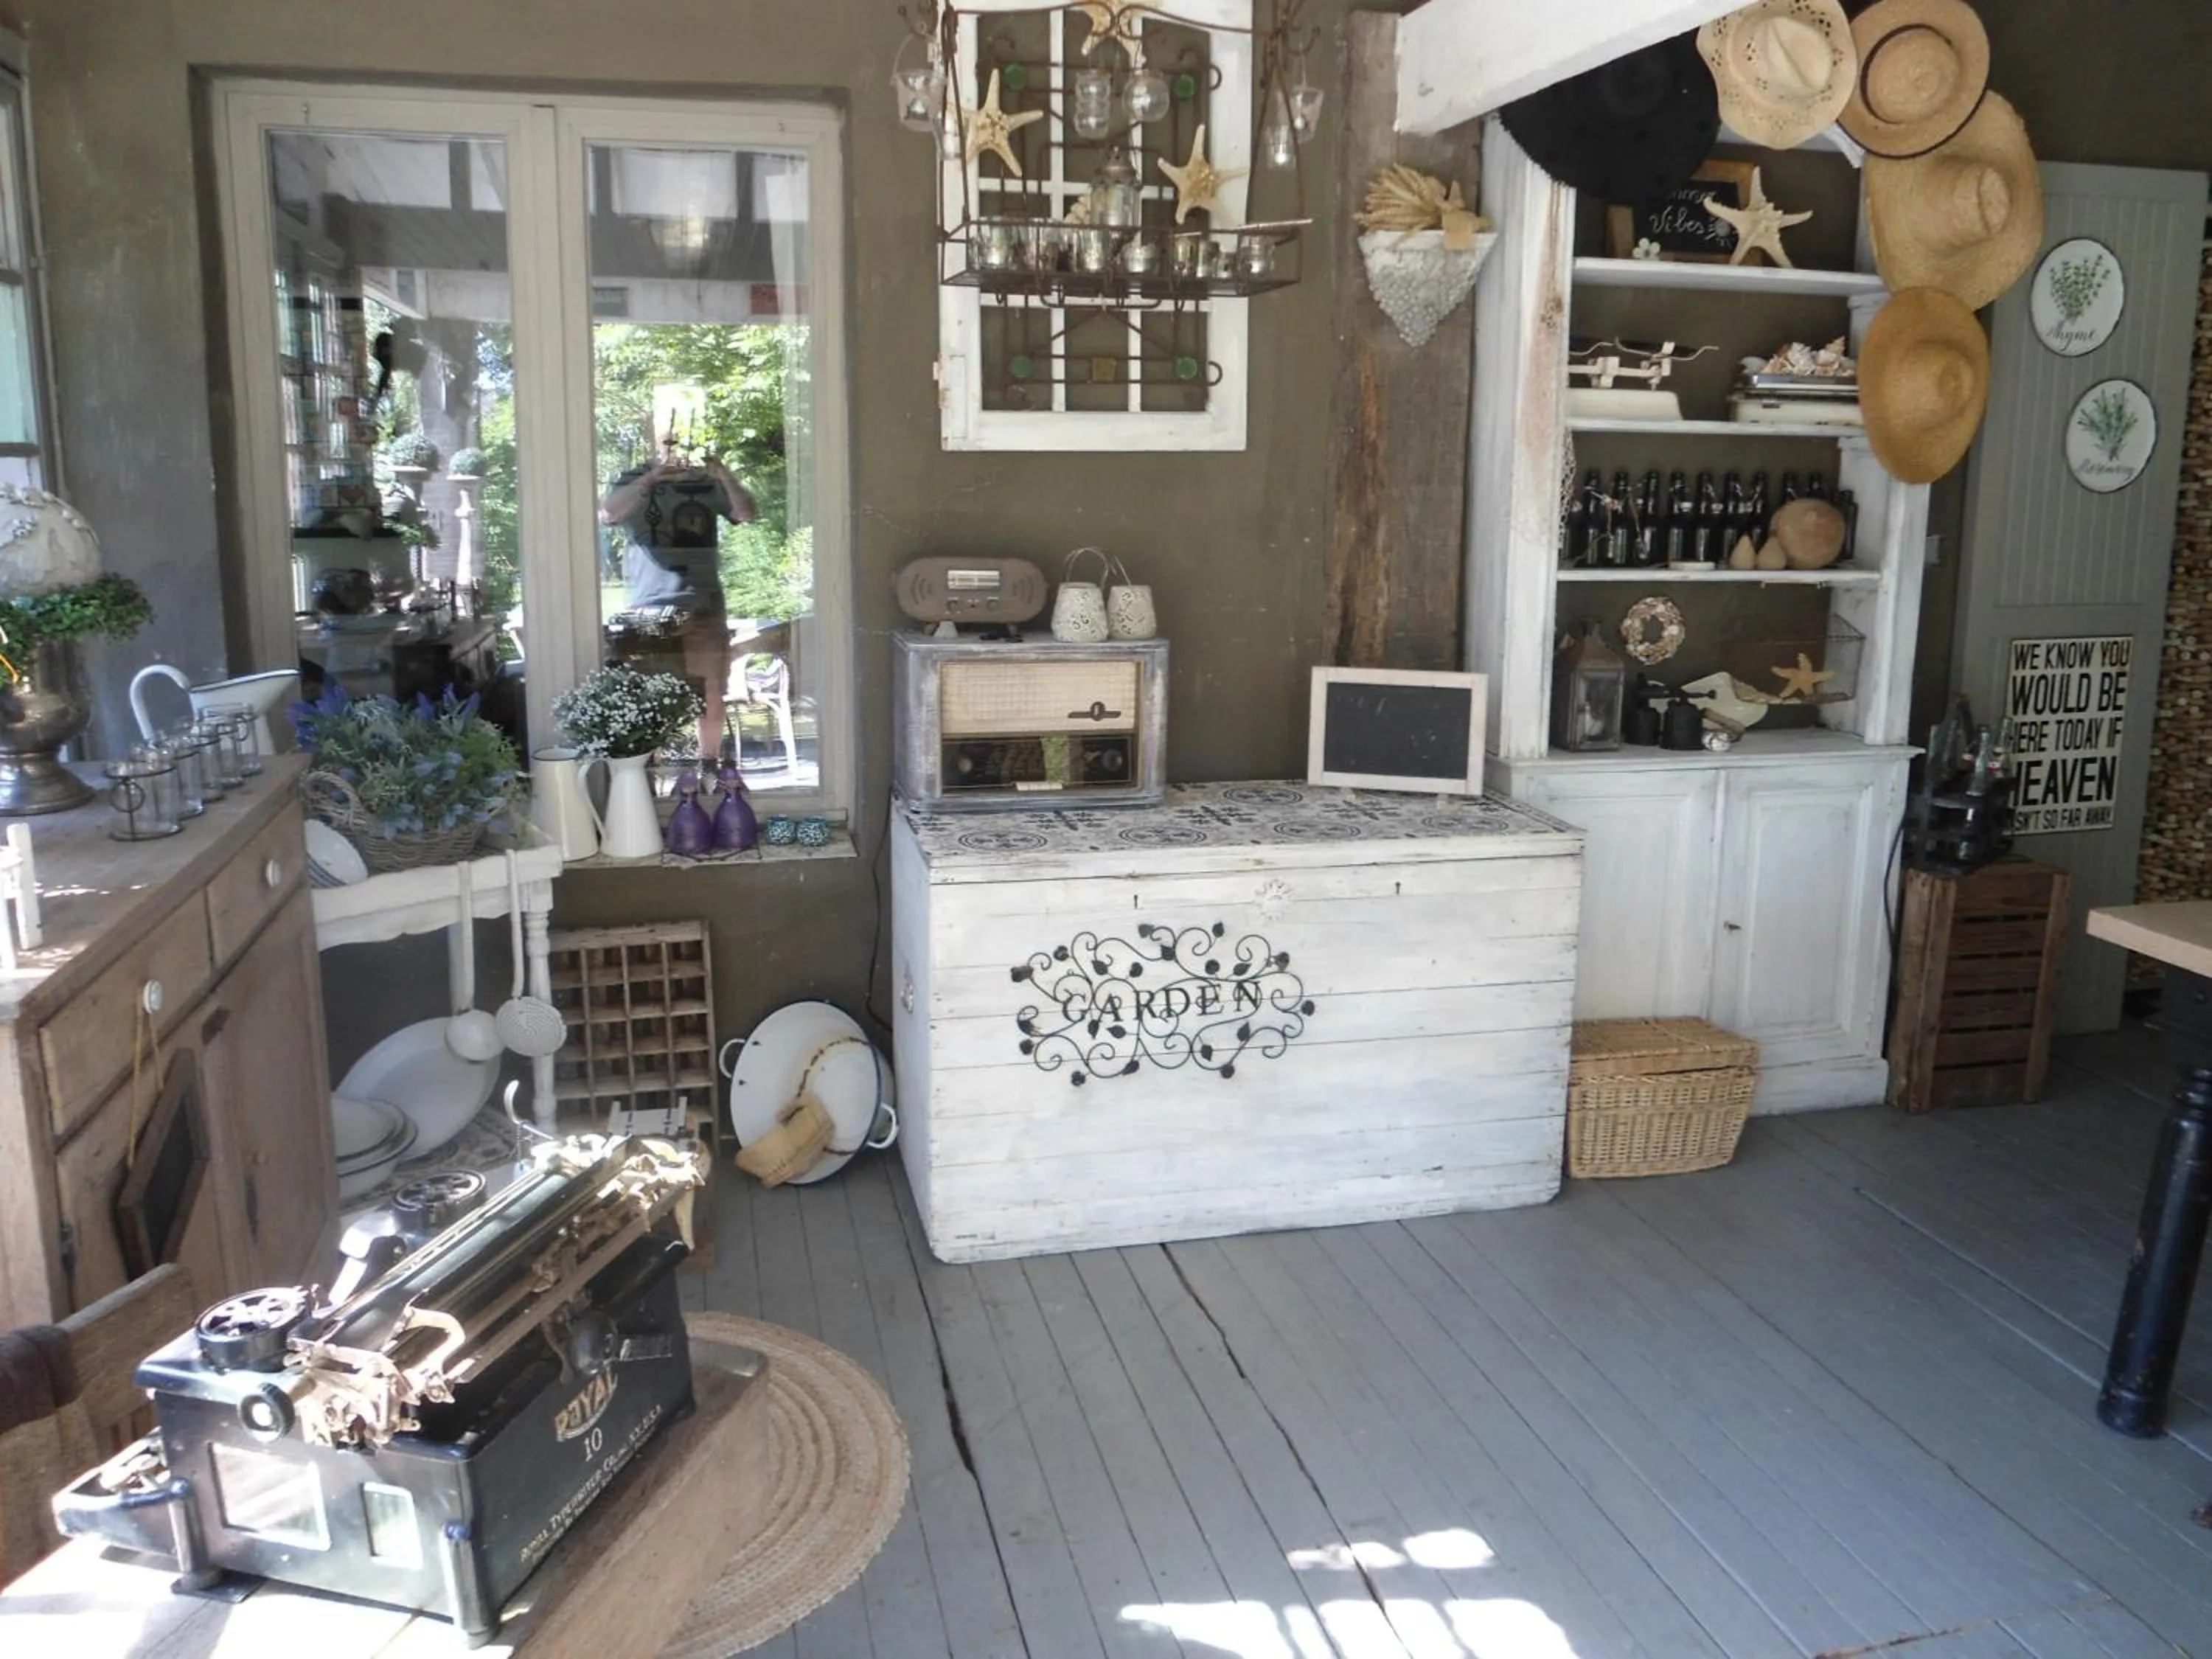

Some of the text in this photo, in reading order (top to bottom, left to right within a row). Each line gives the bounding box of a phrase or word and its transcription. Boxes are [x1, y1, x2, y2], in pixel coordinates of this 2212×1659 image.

[1649, 205, 1705, 234] Vibes
[2014, 640, 2132, 670] WE KNOW YOU
[2011, 672, 2127, 716] WOULD BE
[2054, 718, 2104, 751] TODAY
[2107, 717, 2123, 748] IF
[2043, 809, 2058, 830] SO
[2062, 807, 2081, 827] FAR
[1062, 981, 1261, 1022] GARDEN
[554, 1363, 619, 1441] ROYAL
[583, 1427, 602, 1461] 10
